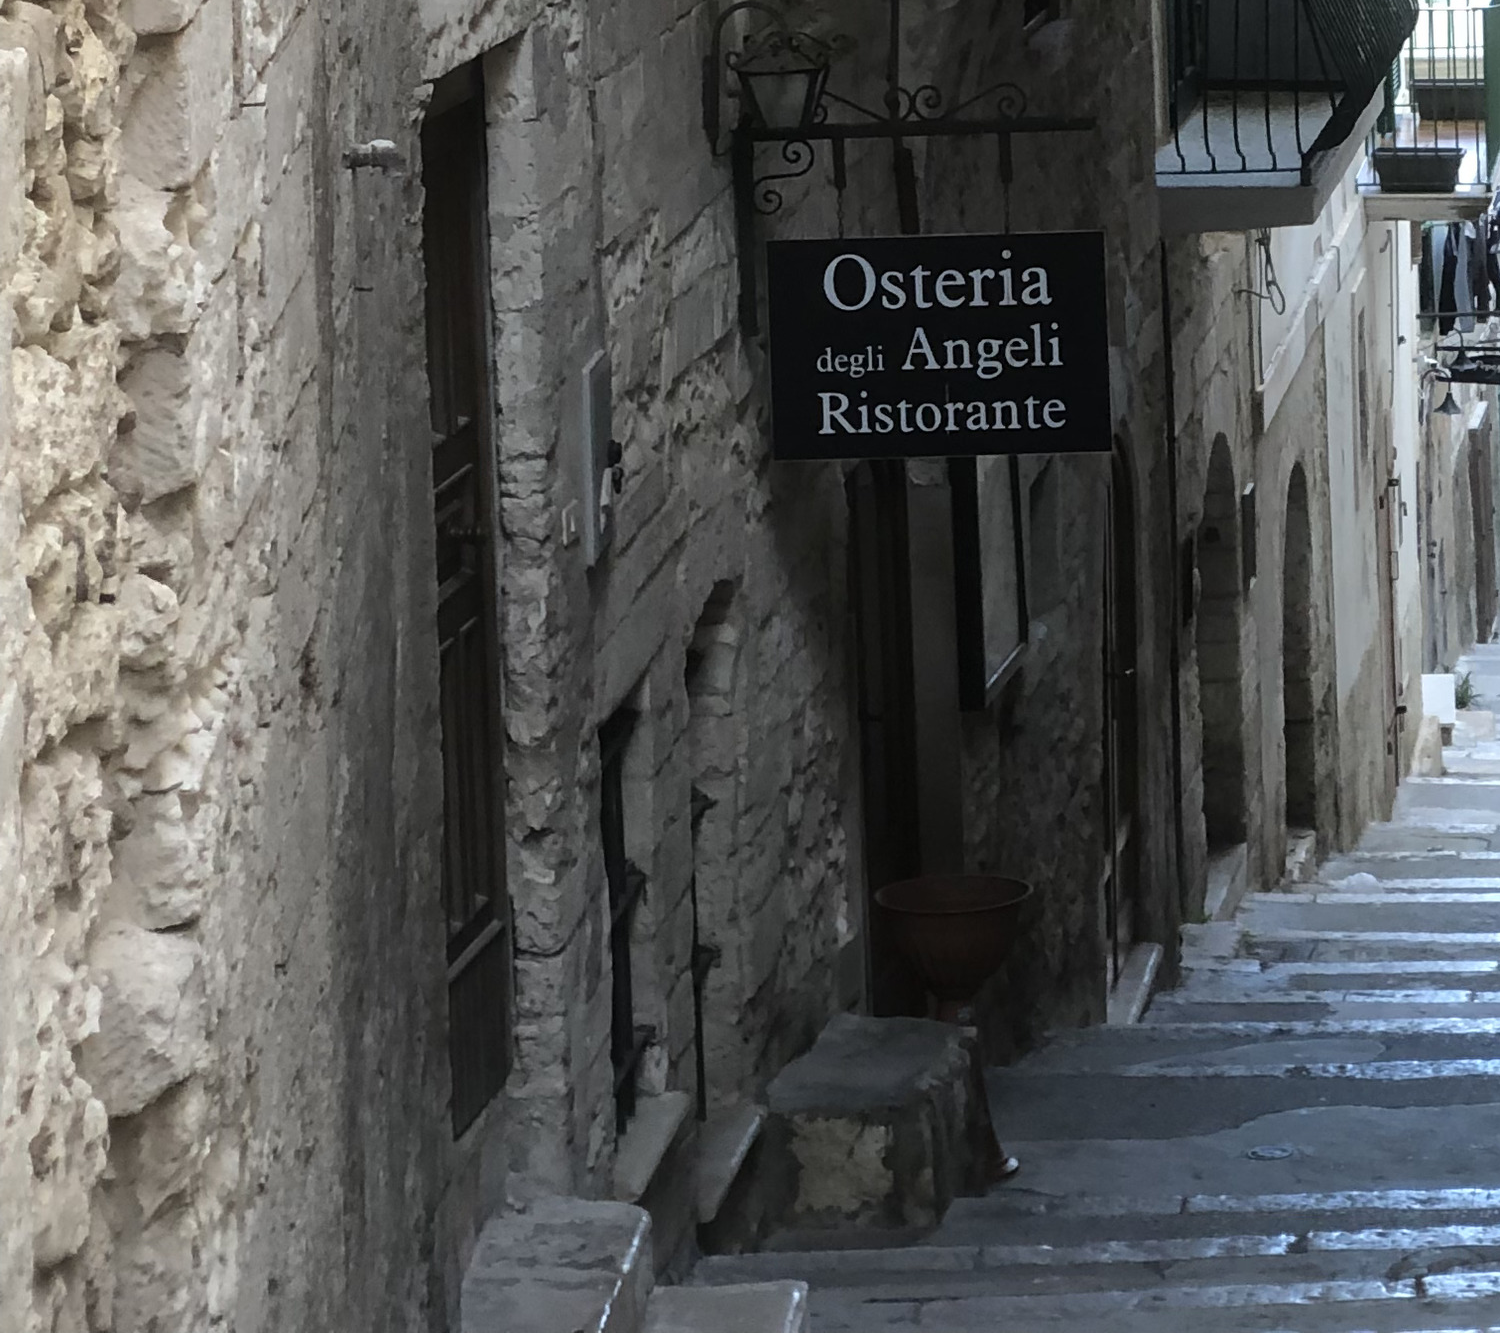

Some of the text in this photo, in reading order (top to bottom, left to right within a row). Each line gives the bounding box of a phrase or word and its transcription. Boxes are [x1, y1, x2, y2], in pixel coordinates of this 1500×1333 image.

[823, 249, 1053, 311] Osteria
[816, 322, 1064, 380] degli Angeli
[817, 390, 1067, 435] Ristorante
